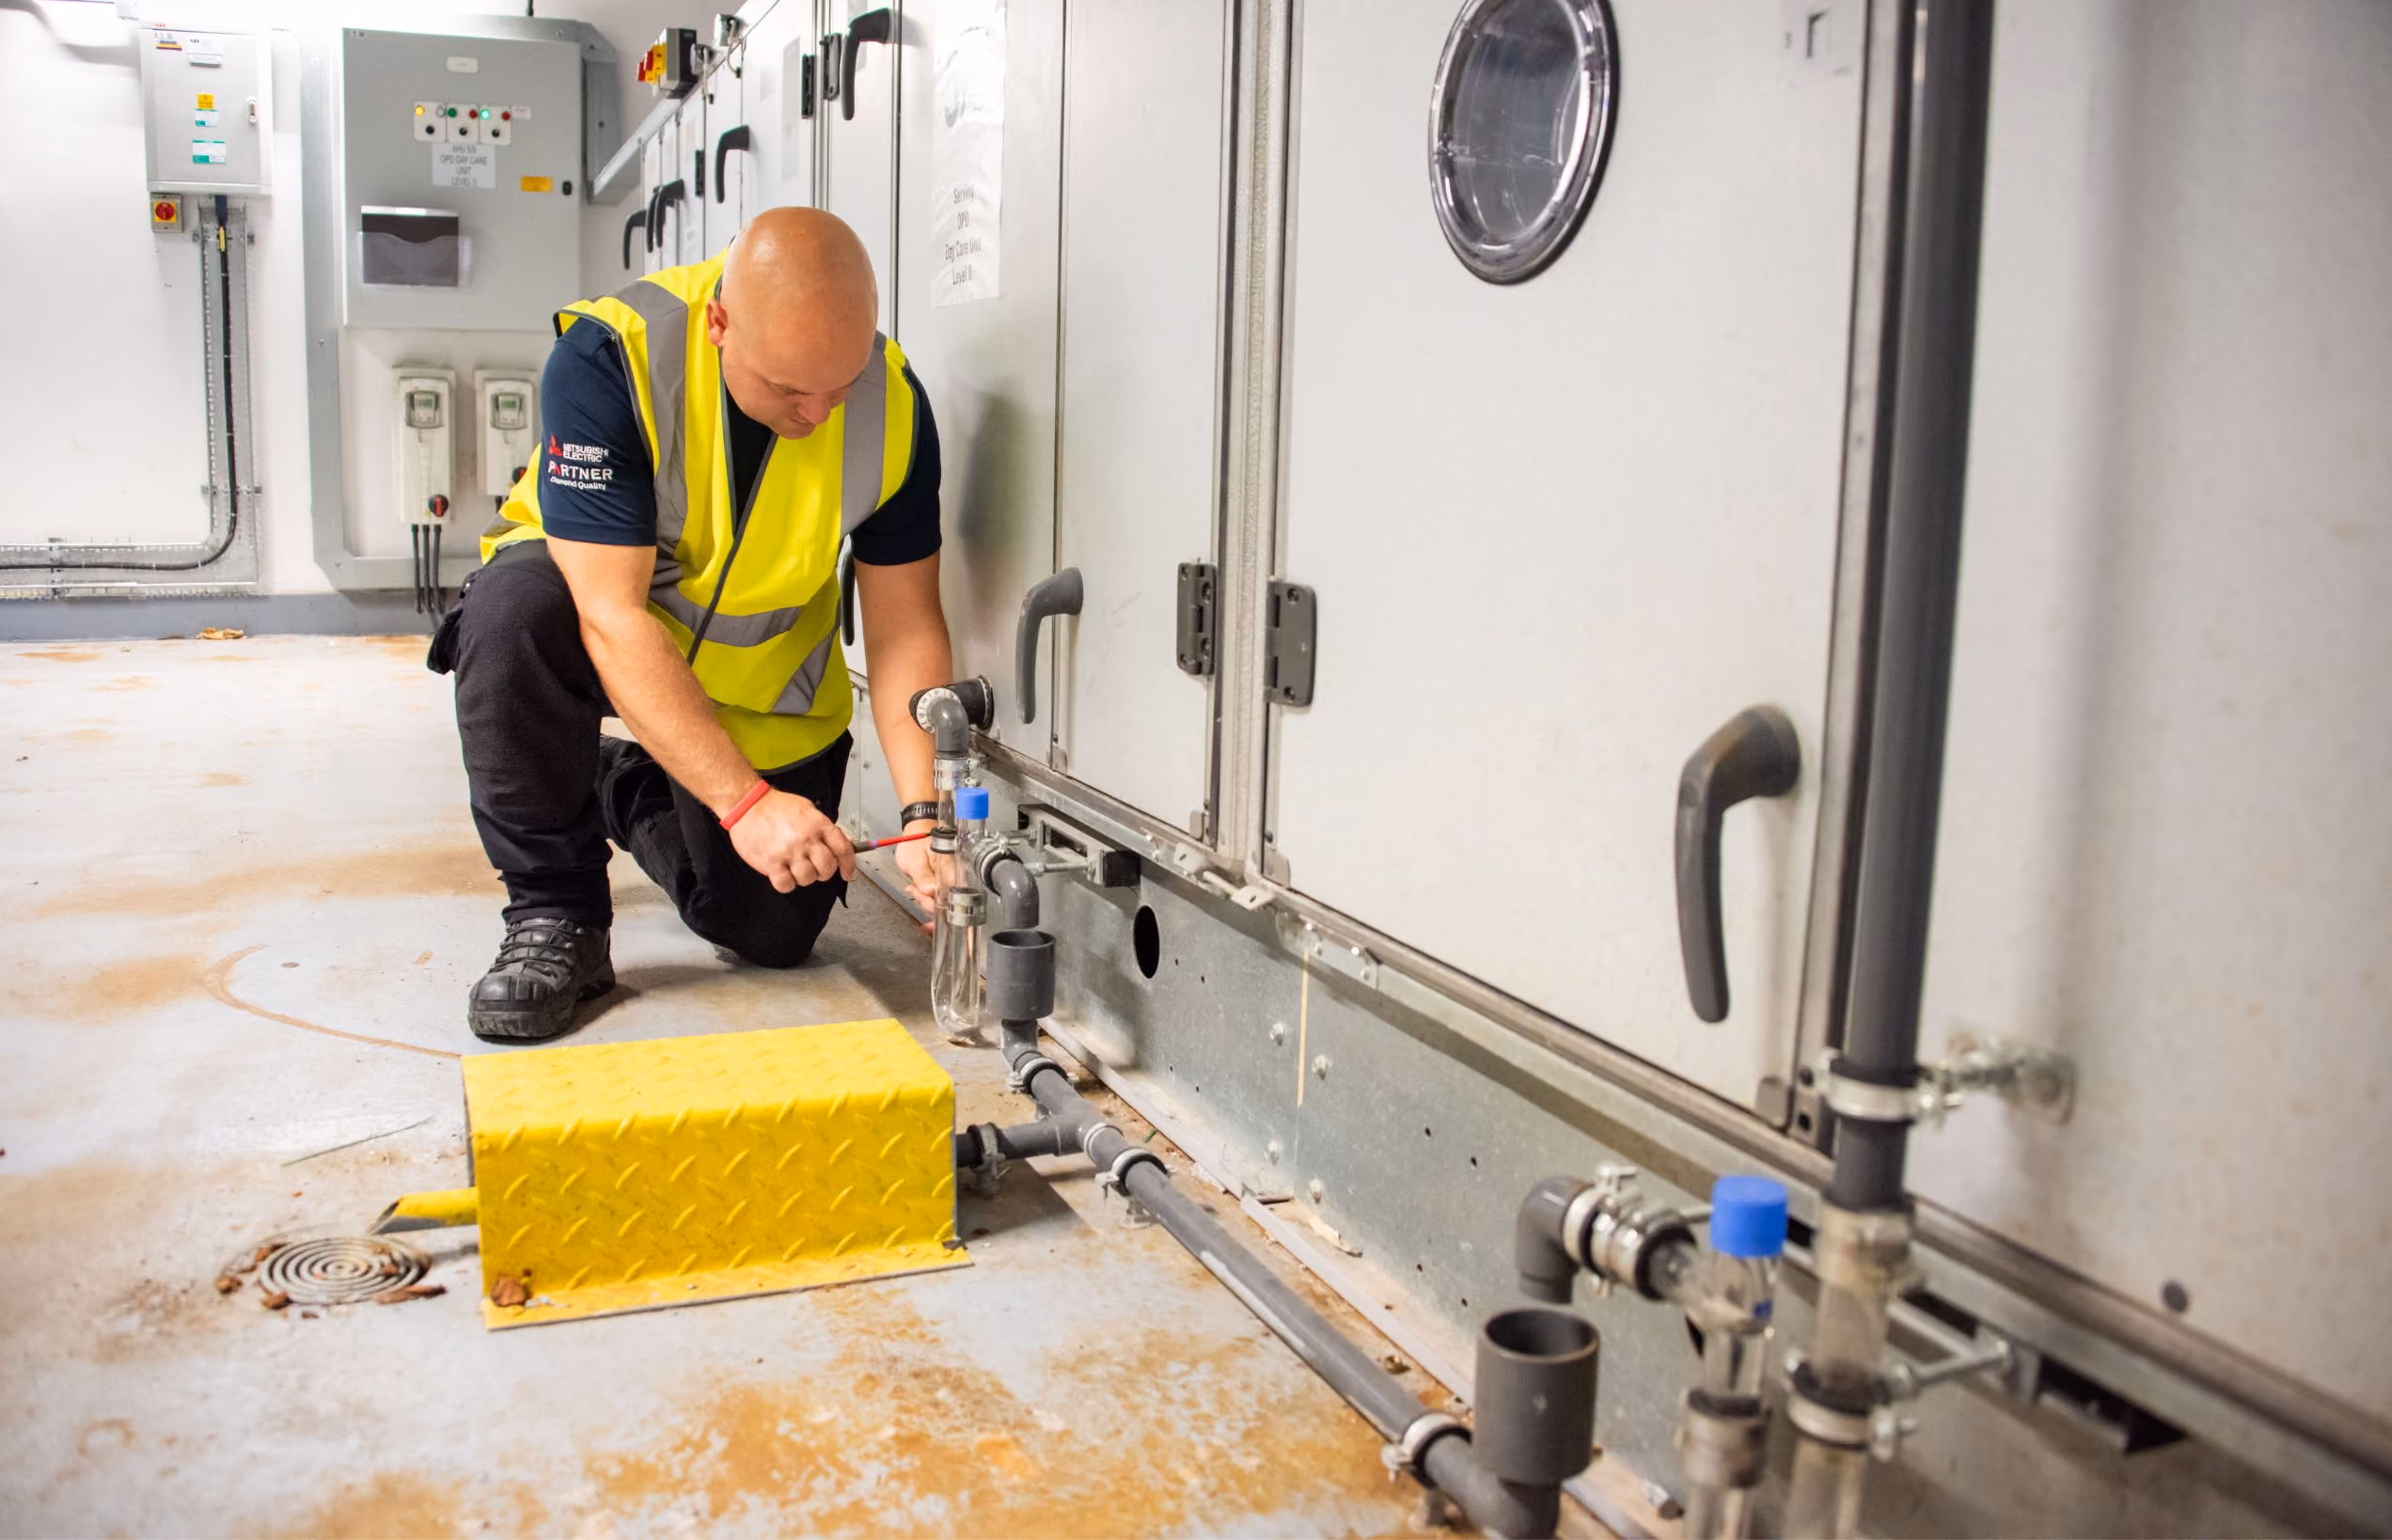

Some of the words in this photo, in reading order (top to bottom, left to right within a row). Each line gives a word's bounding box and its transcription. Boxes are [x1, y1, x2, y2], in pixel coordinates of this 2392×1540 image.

[440, 153, 454, 165] OPD
[456, 154, 468, 165] DAY
[470, 155, 488, 166] CARE
[456, 165, 471, 175] UNIT
[451, 177, 471, 187] LEVEL
[953, 186, 974, 204] Serving
[957, 211, 969, 229] OPD
[945, 244, 955, 262] Day
[956, 240, 968, 258] Care
[969, 236, 982, 254] Unit
[952, 266, 967, 285] Level
[562, 443, 609, 457] MITSUBISHI
[562, 450, 603, 463] ELECTRIC
[547, 460, 614, 480] PARTNER
[577, 481, 606, 491] Quality
